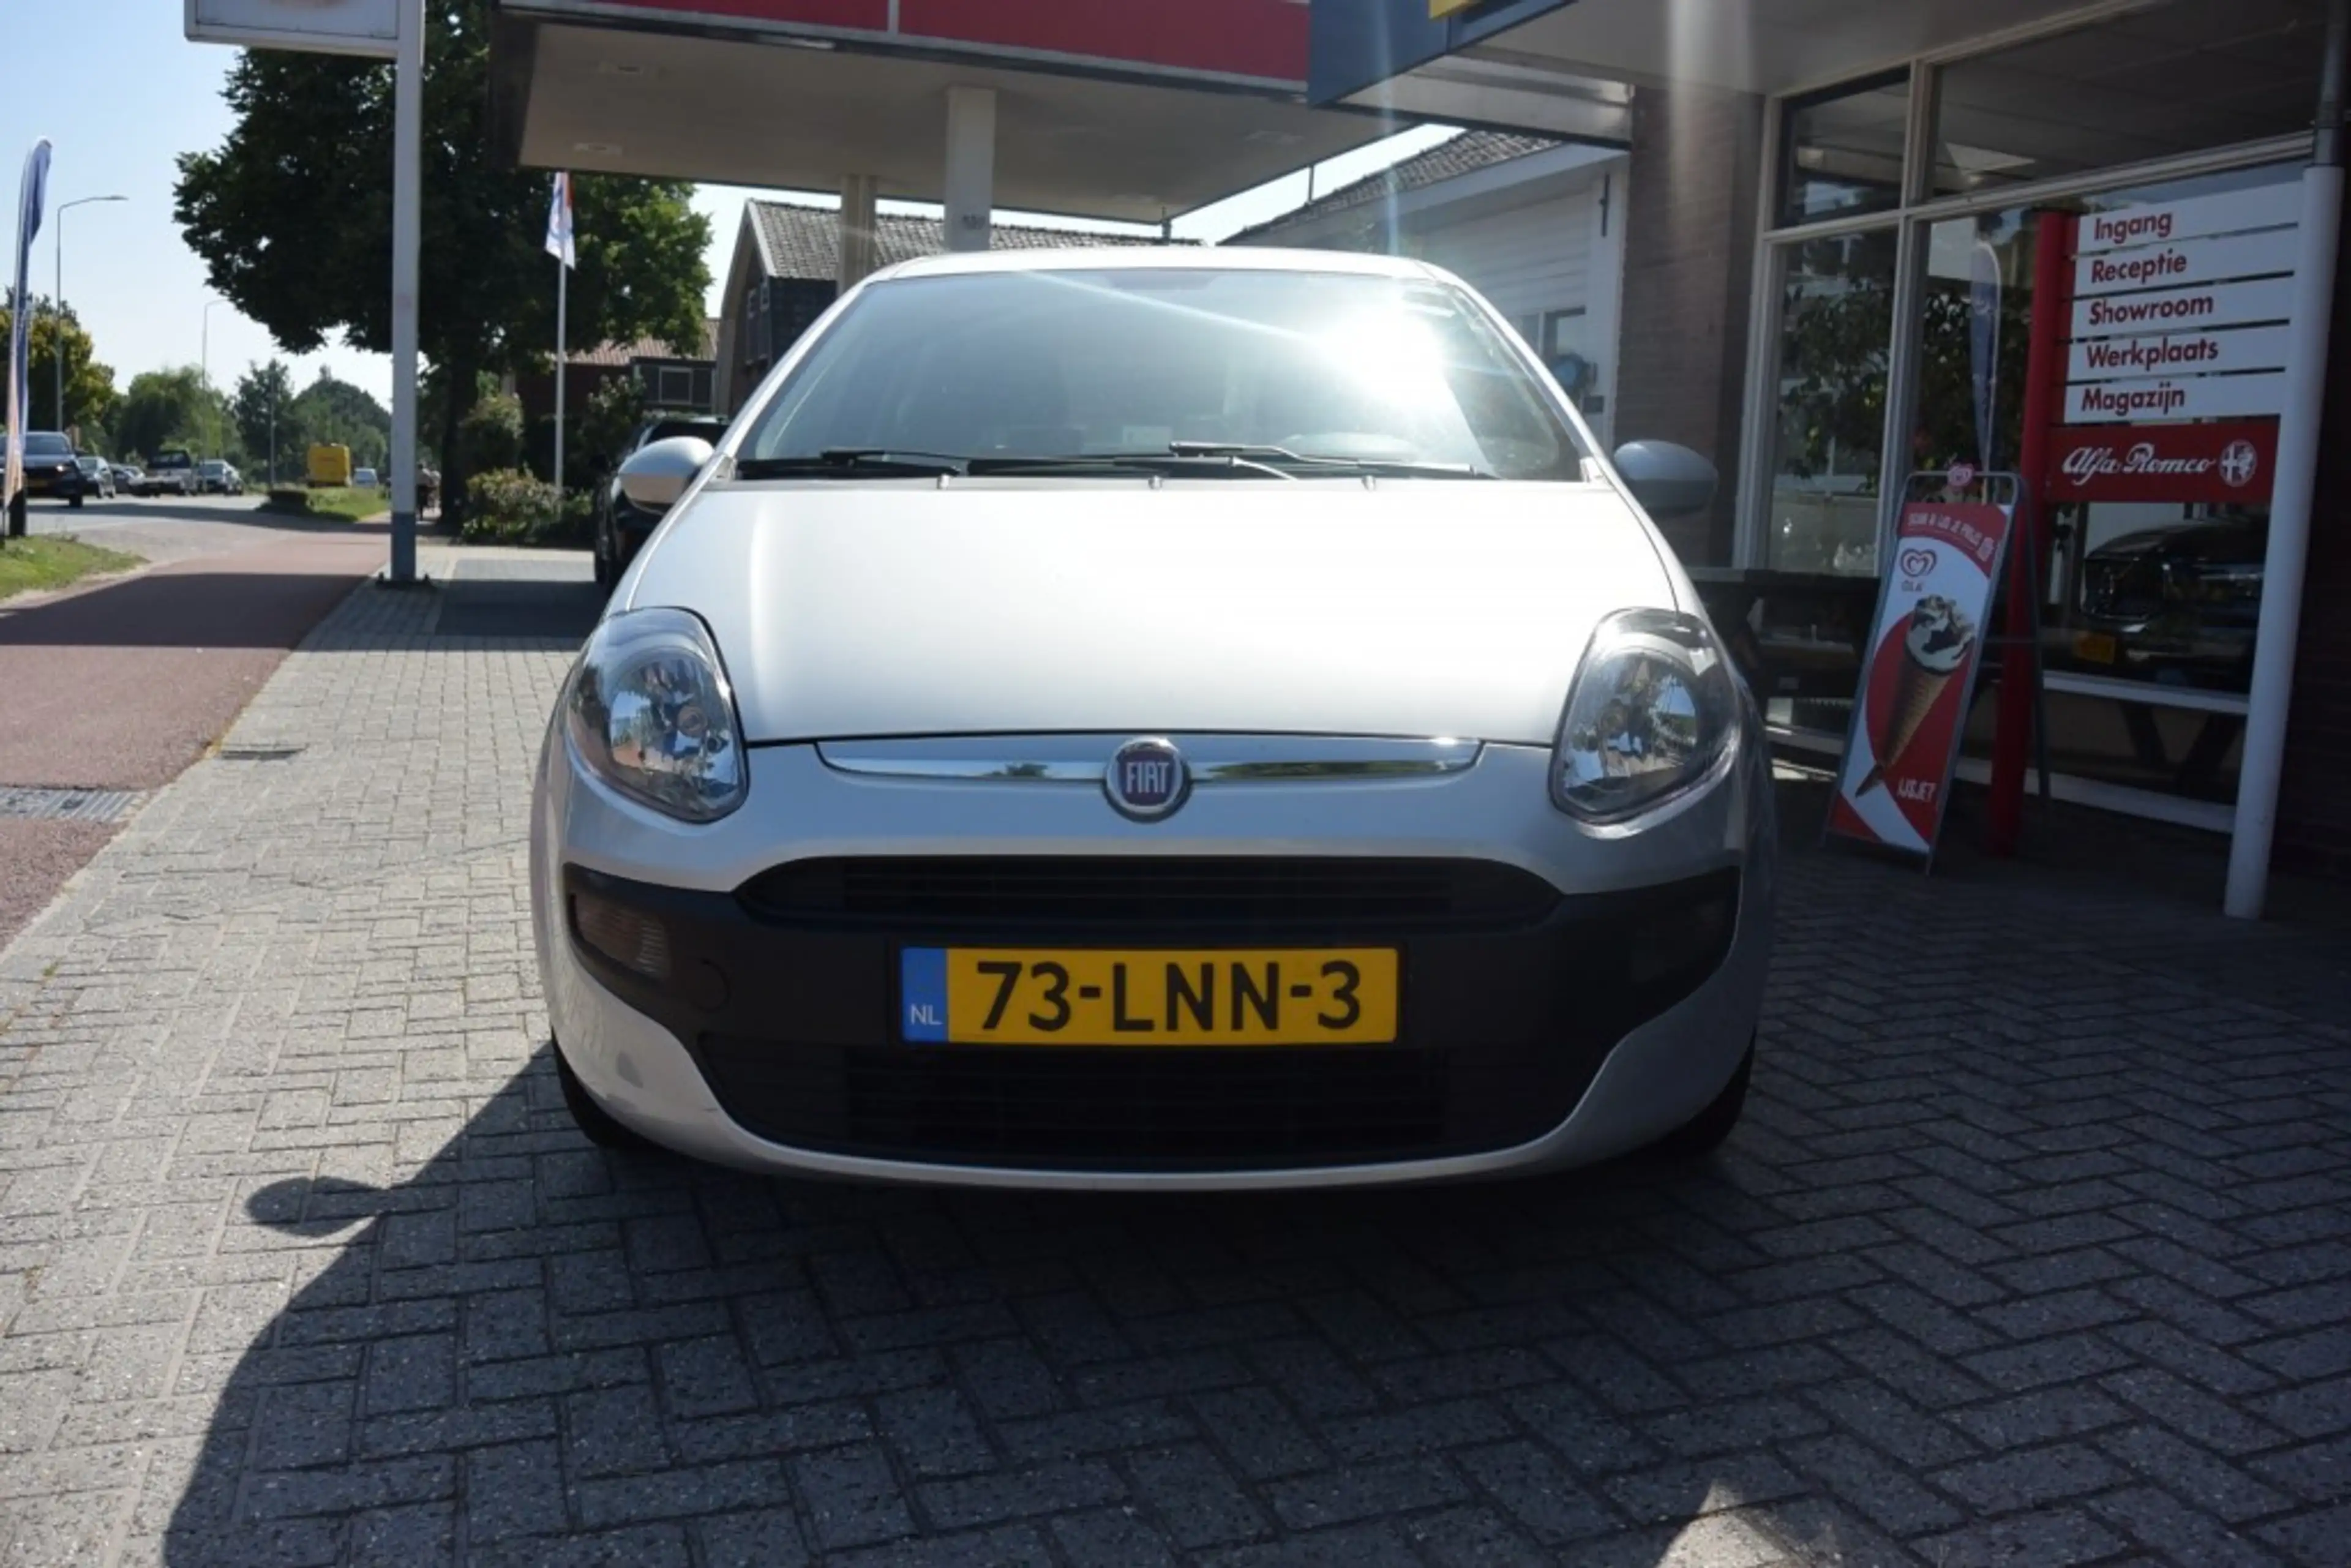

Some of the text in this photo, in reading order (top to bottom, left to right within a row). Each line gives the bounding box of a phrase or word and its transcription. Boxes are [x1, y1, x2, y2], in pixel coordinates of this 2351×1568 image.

[2094, 212, 2172, 244] Ingang
[2091, 249, 2187, 284] Receptie
[2088, 296, 2214, 326] Showroom
[2087, 337, 2219, 370] Werkplaats
[2082, 381, 2186, 416] Magazijn
[2061, 443, 2216, 486] Alfa Romeo
[1126, 762, 1170, 794] FIAT
[977, 961, 1360, 1032] 73-LNN-3
[910, 1004, 942, 1026] NL
